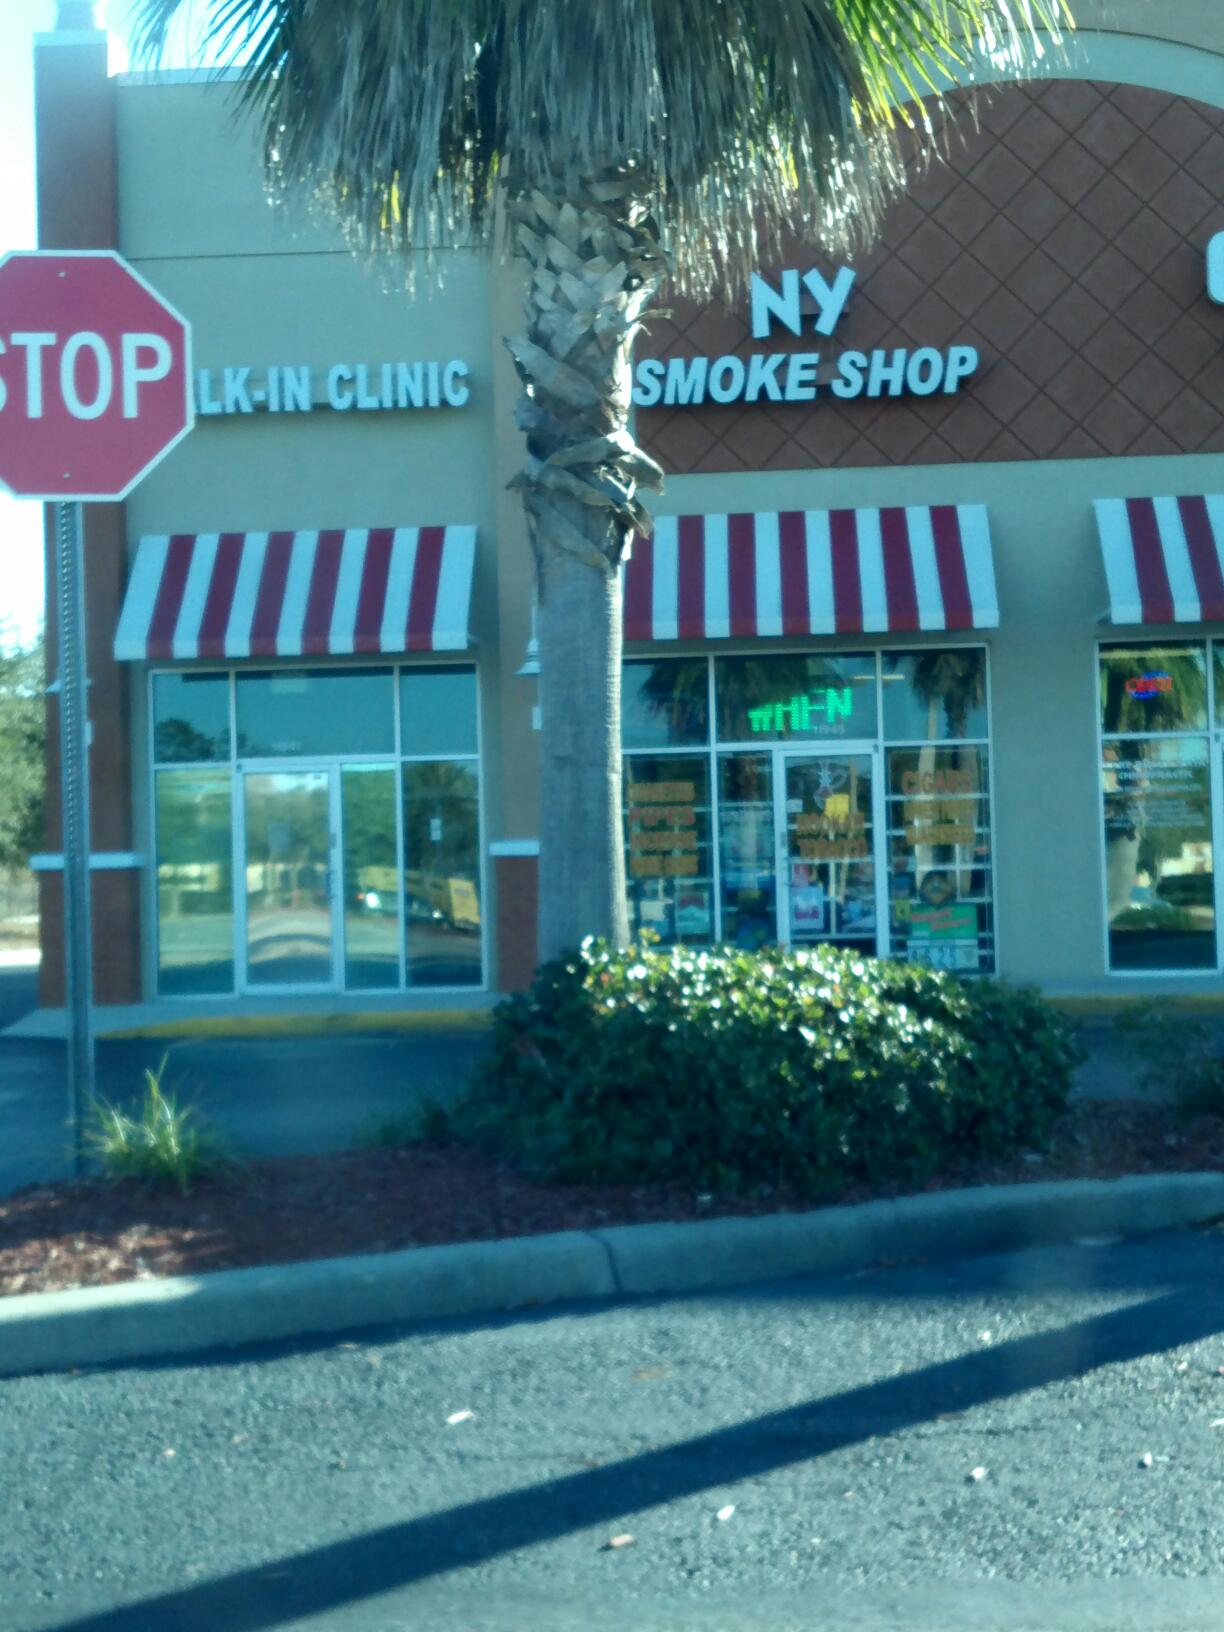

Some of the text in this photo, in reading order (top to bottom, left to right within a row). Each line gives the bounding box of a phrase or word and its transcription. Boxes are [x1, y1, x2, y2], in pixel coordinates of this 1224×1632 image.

[750, 266, 856, 338] NY
[0, 331, 172, 420] TOP
[196, 359, 470, 415] LK-IN CLINIC
[631, 346, 979, 406] SMOKE SHOP
